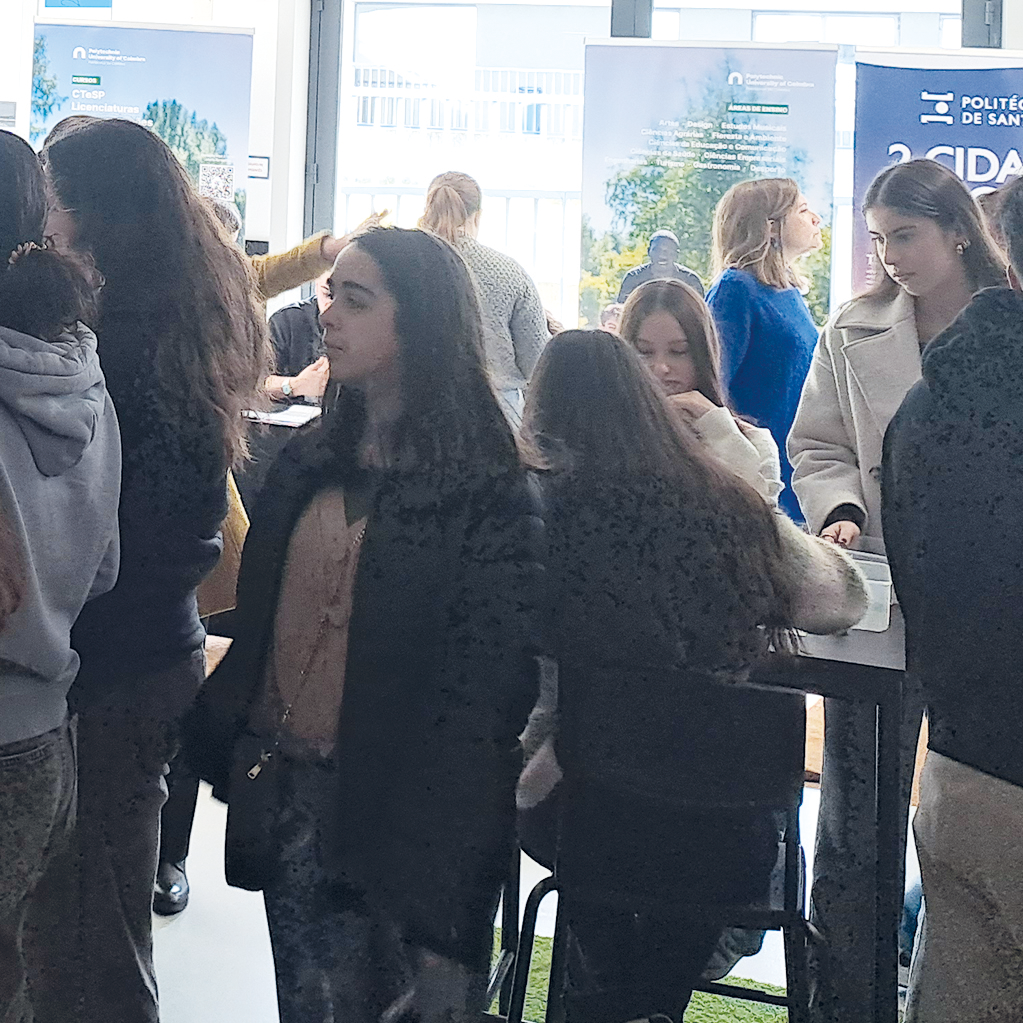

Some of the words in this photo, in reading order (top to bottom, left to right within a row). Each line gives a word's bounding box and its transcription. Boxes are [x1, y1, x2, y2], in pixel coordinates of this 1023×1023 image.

[72, 89, 106, 99] CTeSP
[71, 101, 140, 114] Licenciaturas
[961, 112, 982, 125] DE
[988, 113, 1023, 126] SAN
